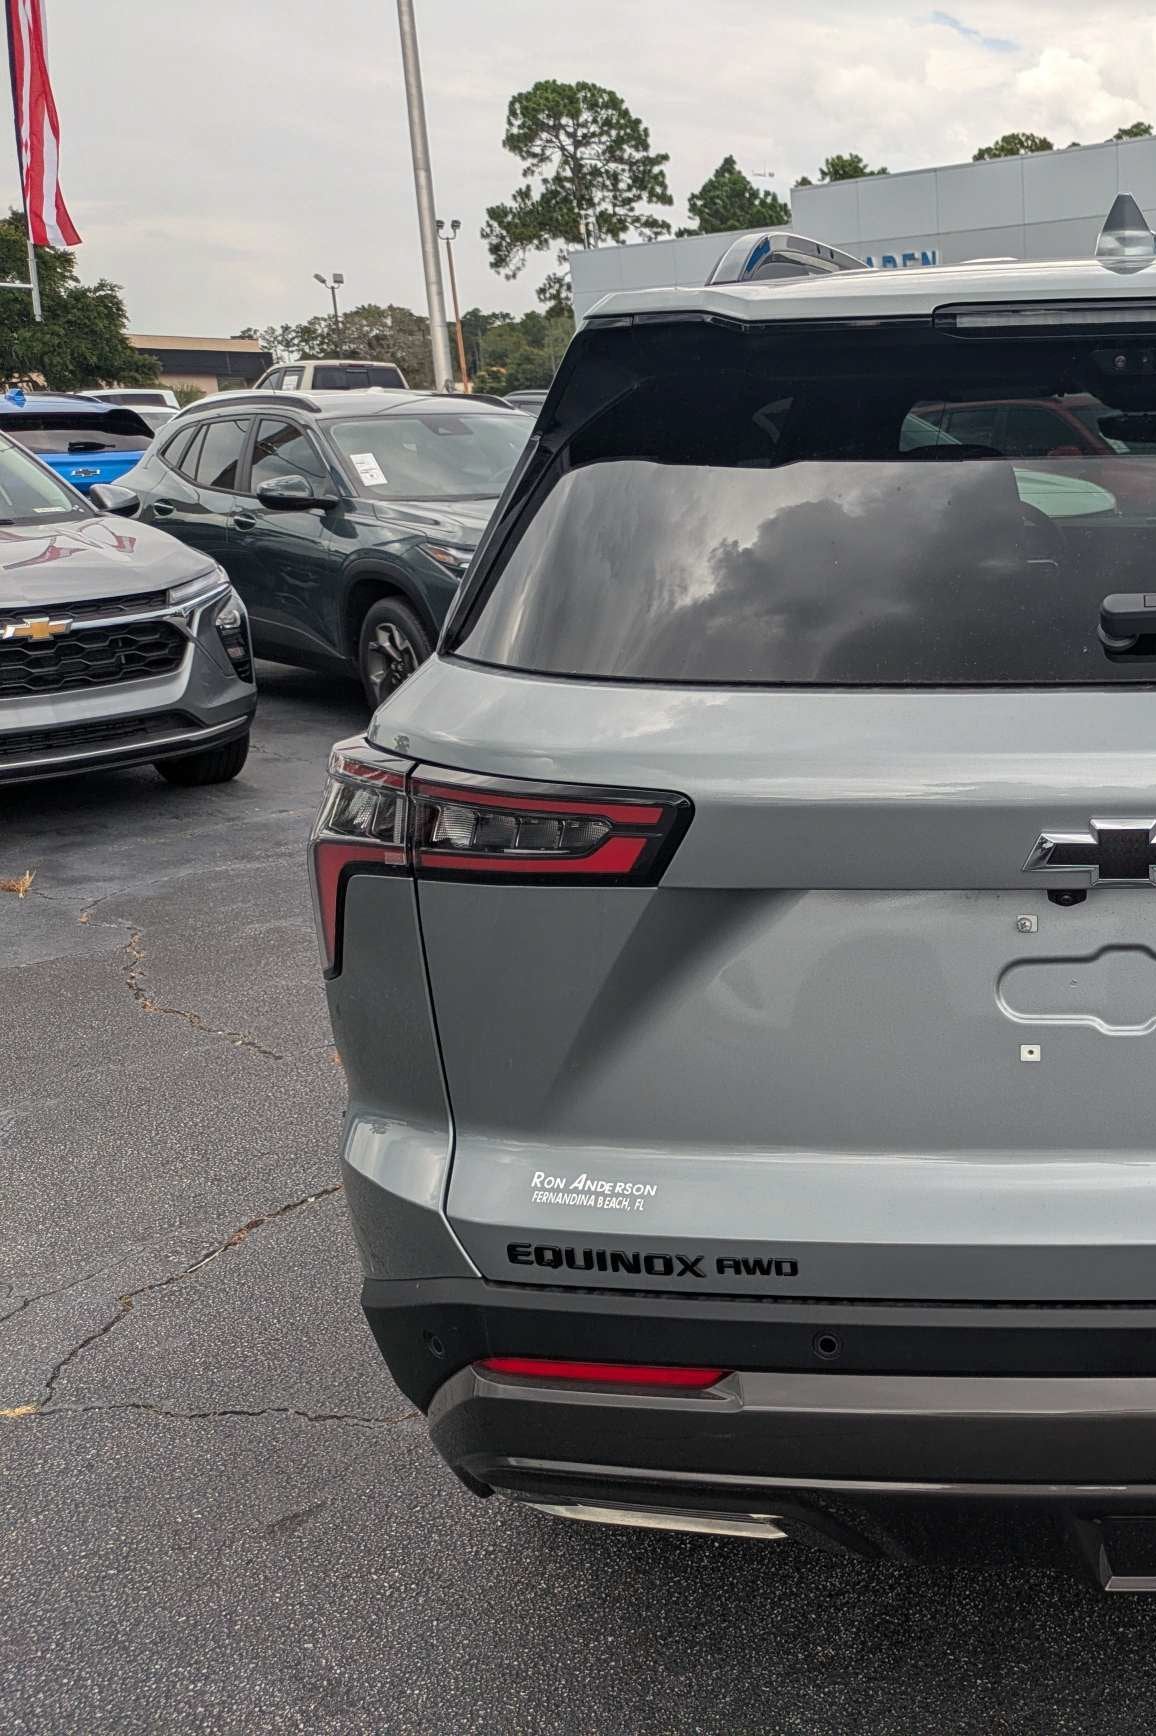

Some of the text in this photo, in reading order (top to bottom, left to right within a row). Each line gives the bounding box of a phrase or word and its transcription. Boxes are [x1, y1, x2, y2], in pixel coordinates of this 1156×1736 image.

[531, 1171, 658, 1196] RON ANDERSON
[532, 1191, 645, 1211] FERNANDINA BEACH, FL
[506, 1242, 799, 1278] EQUINOX AWD
